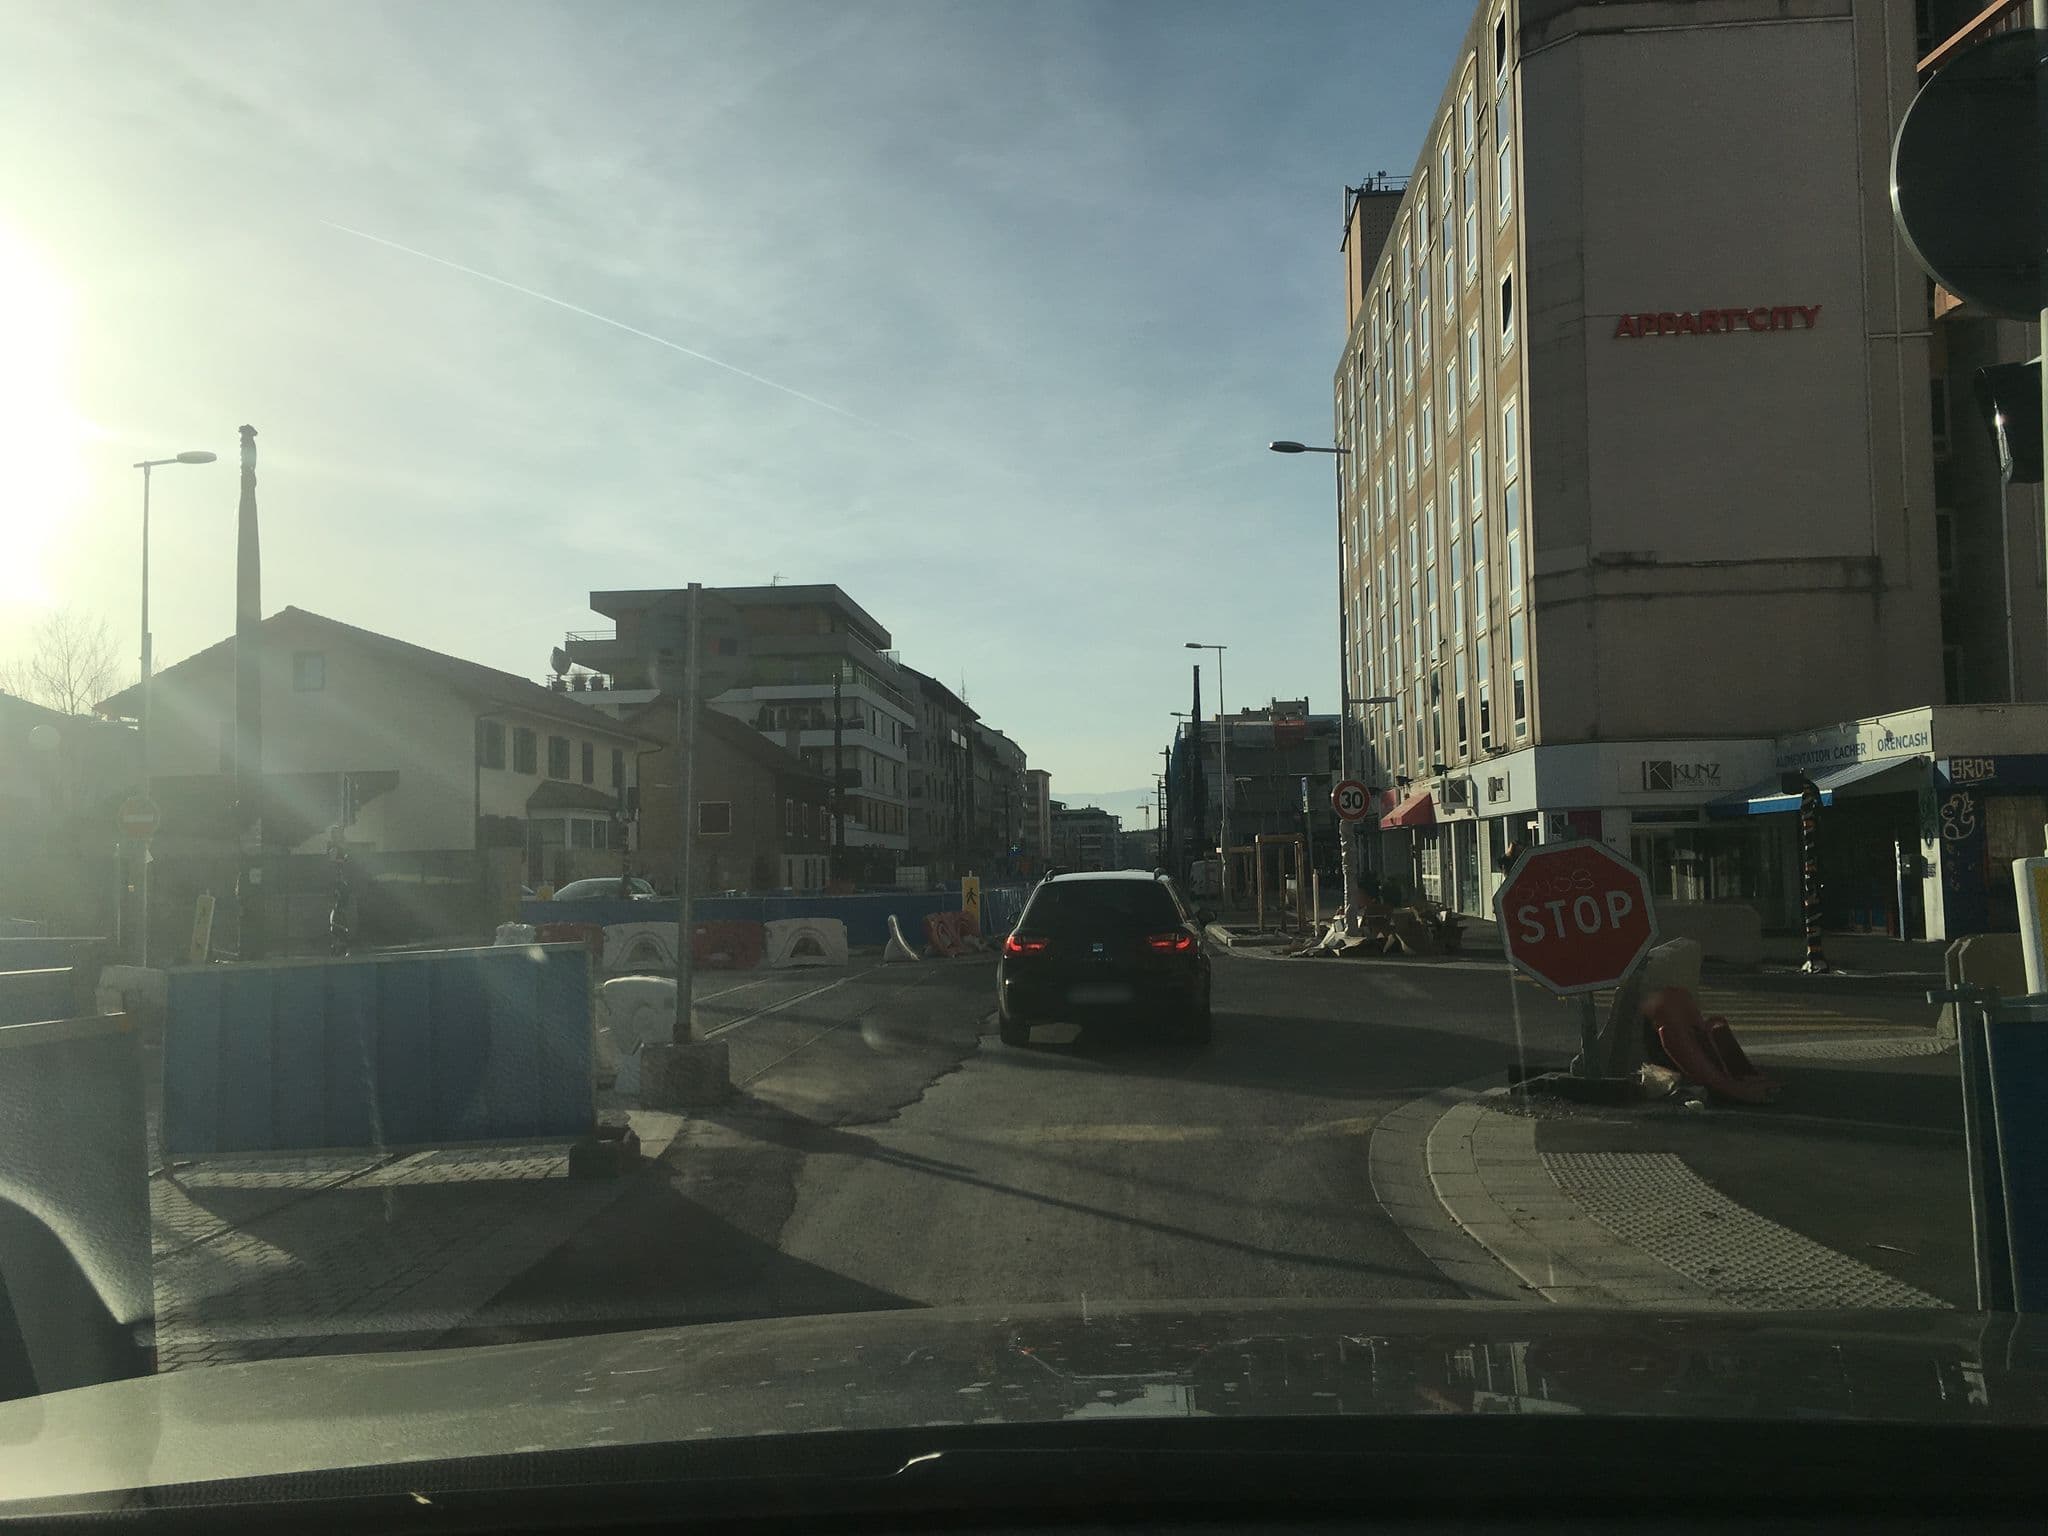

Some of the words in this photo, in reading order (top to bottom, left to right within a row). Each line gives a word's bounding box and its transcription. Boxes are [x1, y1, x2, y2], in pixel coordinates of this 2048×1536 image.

[1834, 742, 1867, 760] CACHER
[1877, 732, 1929, 752] ORENCASH
[1673, 763, 1721, 779] KUNZ
[1341, 790, 1364, 810] 30
[1517, 889, 1634, 944] STOP
